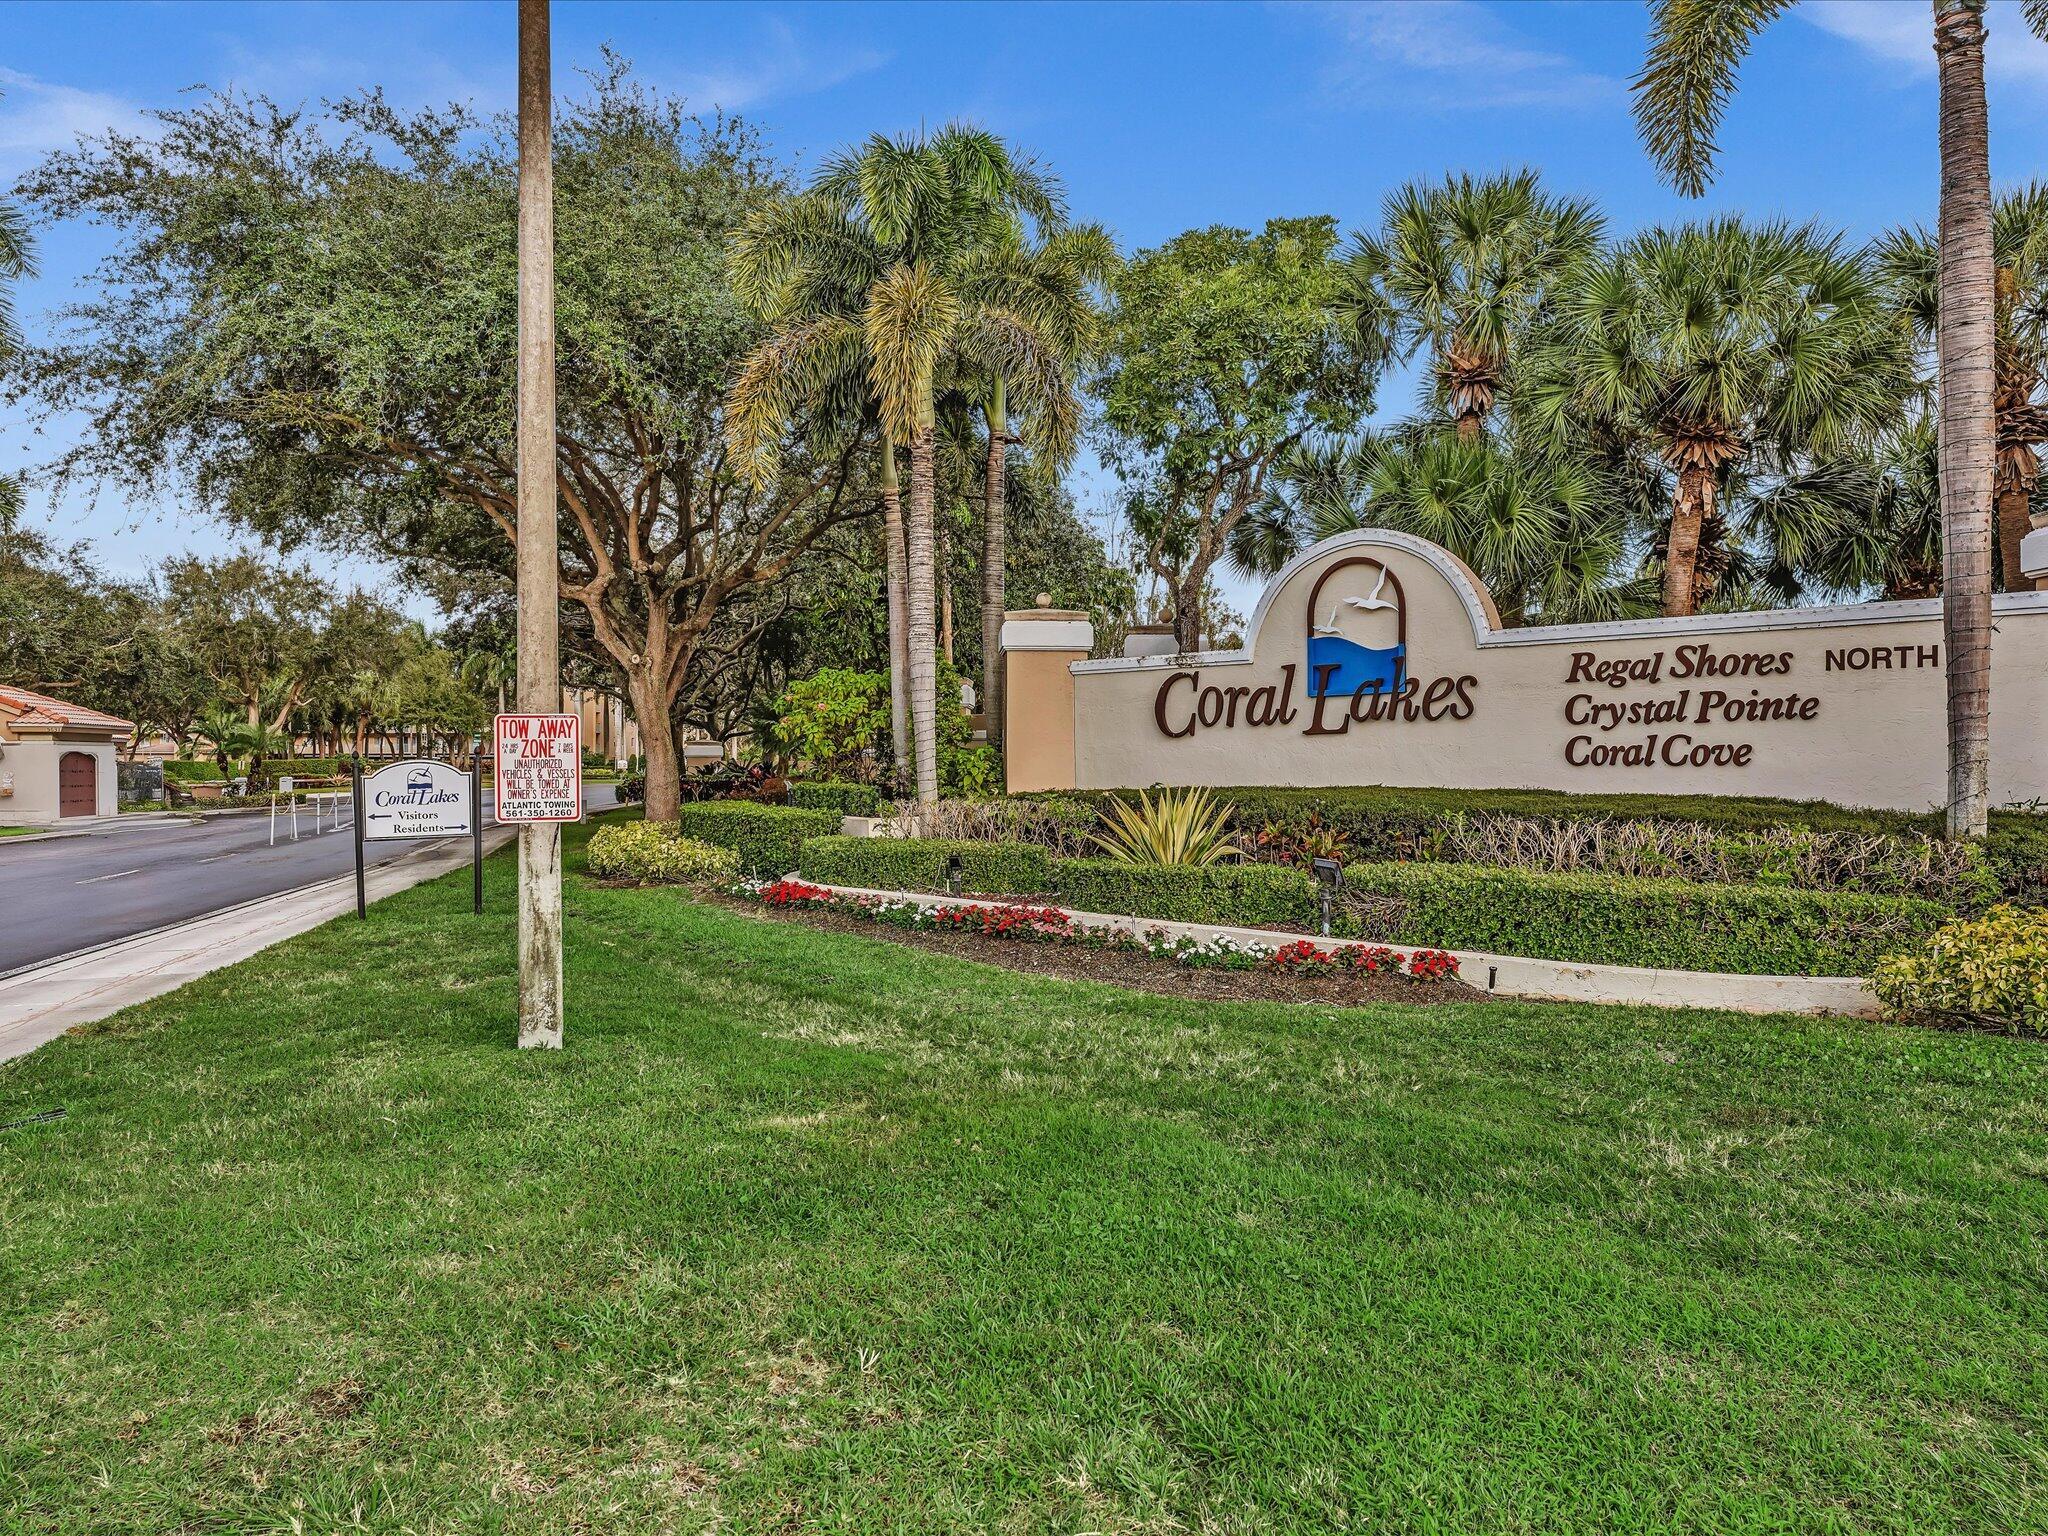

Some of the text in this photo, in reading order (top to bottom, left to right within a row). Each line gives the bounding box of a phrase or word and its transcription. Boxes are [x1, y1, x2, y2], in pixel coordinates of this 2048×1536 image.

[1825, 645, 1939, 671] NORTH
[1565, 644, 1794, 688] Regal Shores
[1154, 656, 1478, 739] Coral Lakes
[1565, 689, 1820, 731] Crystal Pointe
[501, 719, 574, 738] TOW AWAY
[521, 739, 555, 758] ZONE
[1564, 733, 1753, 767] Coral Cove
[514, 759, 563, 769] UNAUTHORIZED
[502, 769, 575, 779] VEHICLES & VESSELS
[507, 779, 570, 789] WILL BE TOWED AT
[375, 788, 460, 807] Coral Lakes
[507, 789, 570, 799] OWNER'S EXPENSE
[502, 801, 575, 810] ATLANTIC TOWING
[398, 810, 439, 820] Visitors
[506, 809, 572, 817] 561-350-1260
[393, 824, 444, 833] Residents
